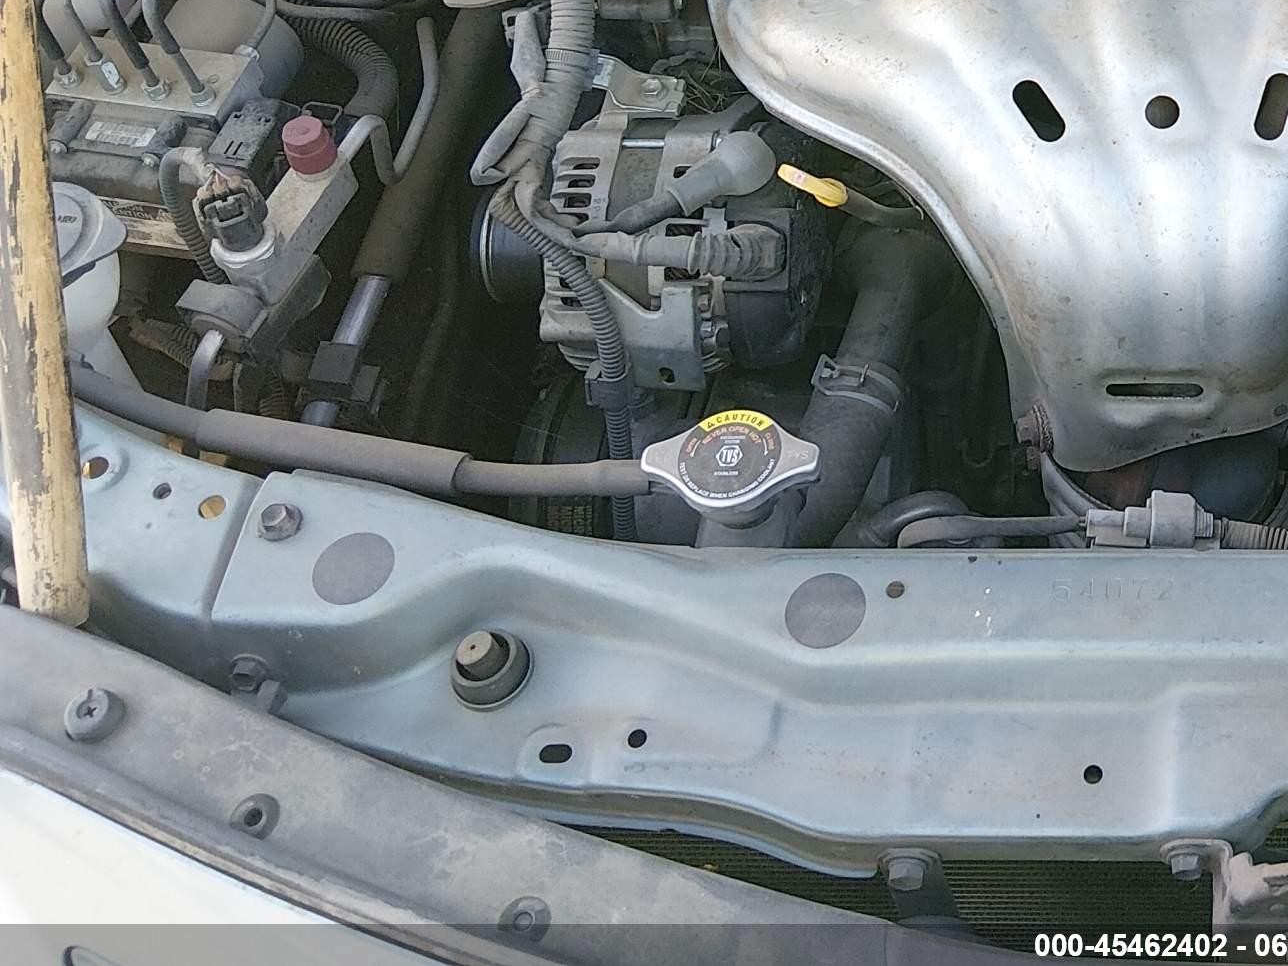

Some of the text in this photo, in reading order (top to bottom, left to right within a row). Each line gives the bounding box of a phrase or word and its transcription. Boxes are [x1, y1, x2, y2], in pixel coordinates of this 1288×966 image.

[715, 413, 766, 428] CAUTION
[728, 425, 750, 435] OPEN
[721, 448, 740, 463] TVS
